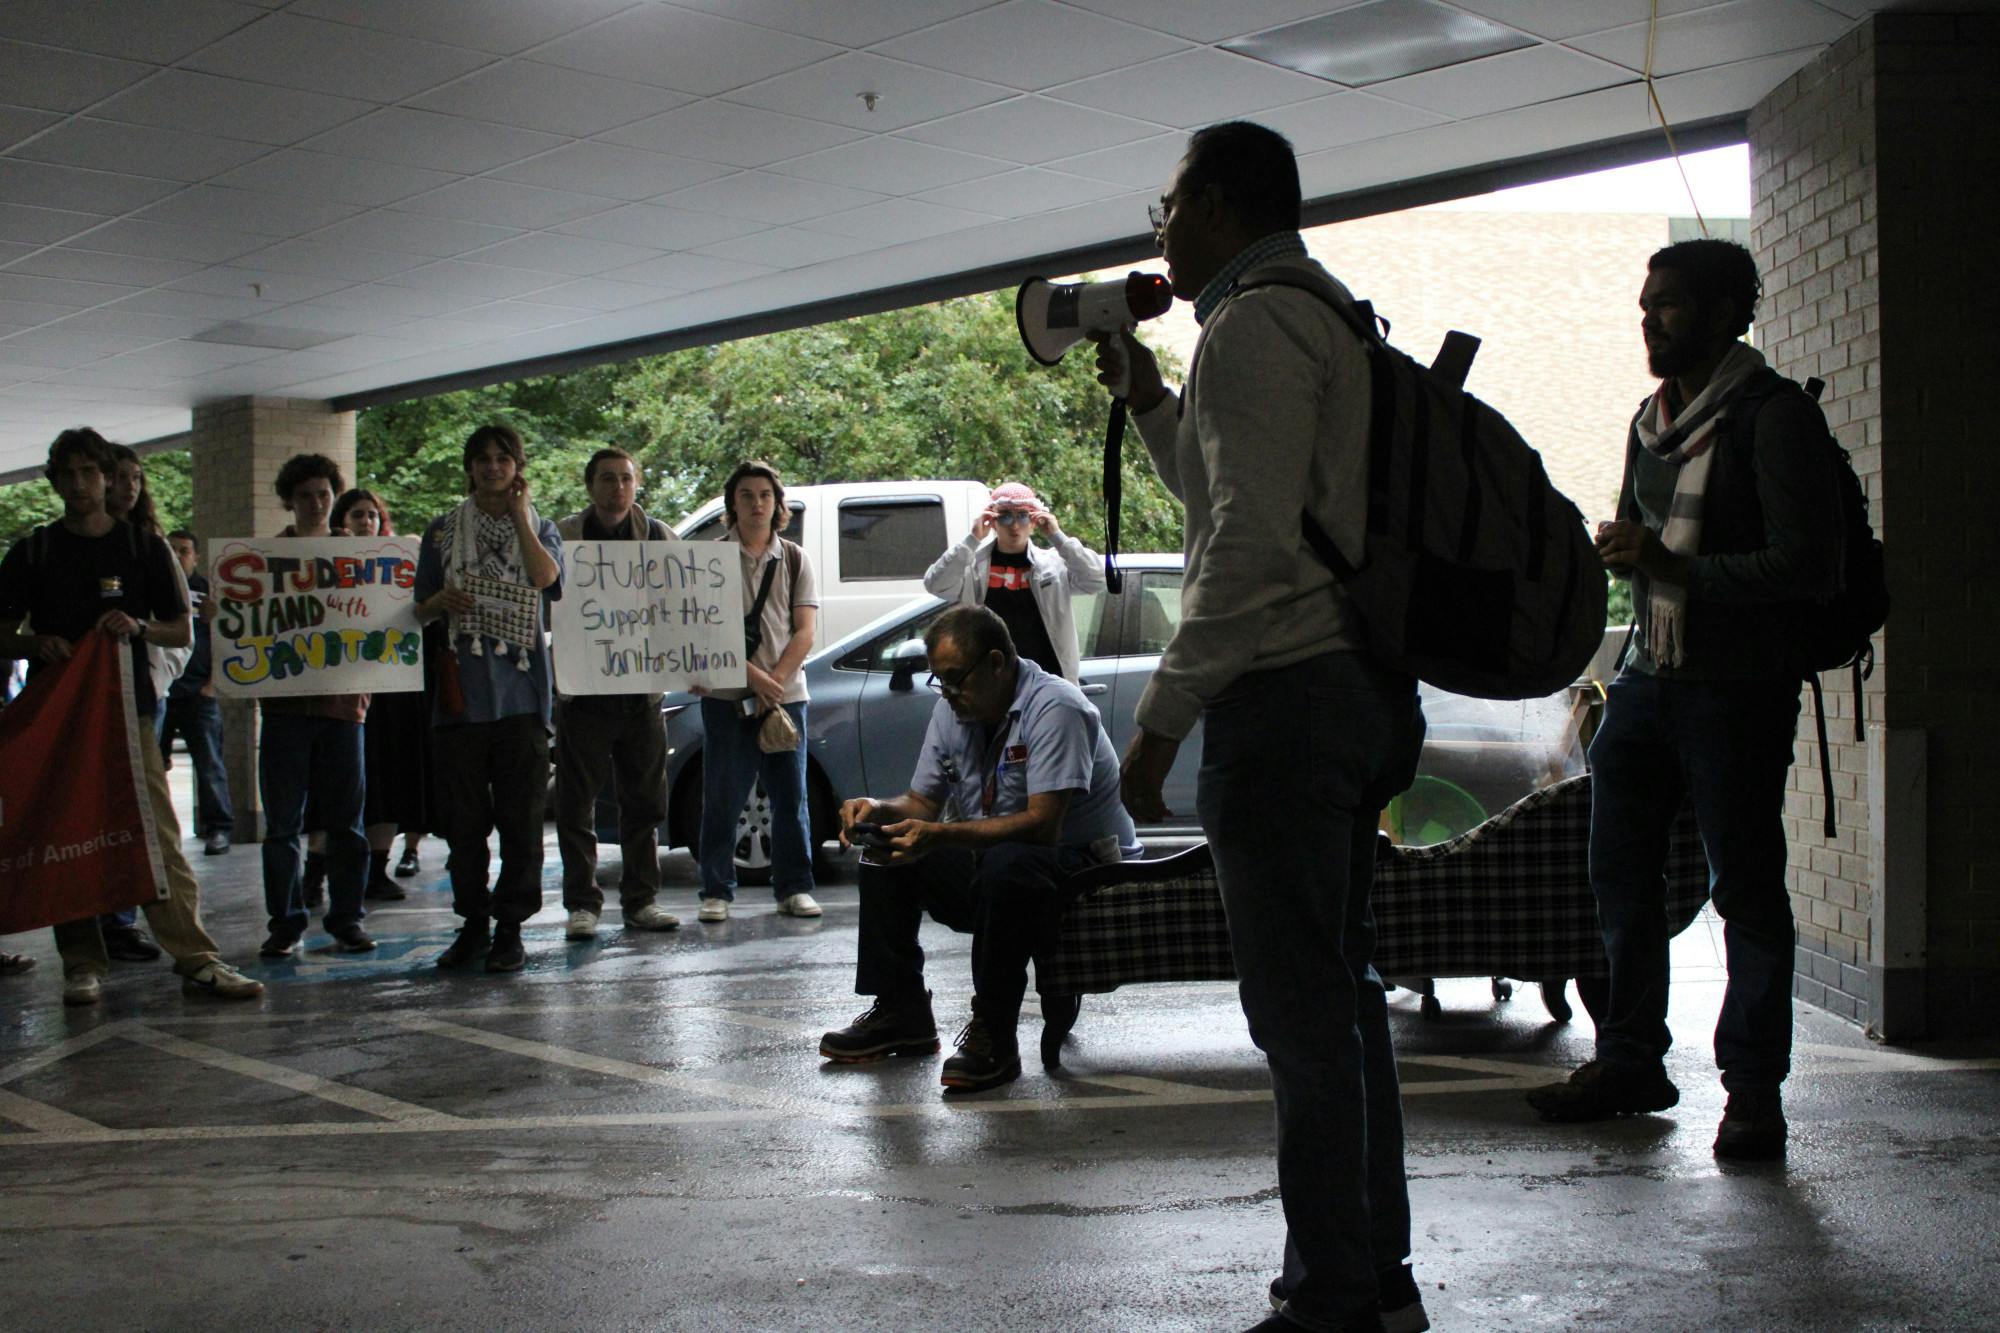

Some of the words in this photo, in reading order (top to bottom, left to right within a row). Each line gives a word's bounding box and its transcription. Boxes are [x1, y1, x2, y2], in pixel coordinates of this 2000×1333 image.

[218, 552, 416, 602] STUDENTS
[573, 542, 726, 590] Students
[218, 594, 326, 640] STAND
[326, 594, 369, 618] with
[581, 597, 671, 636] Support
[678, 596, 724, 625] the
[223, 627, 421, 685] JANITORS
[16, 846, 35, 870] of
[43, 829, 133, 864] America
